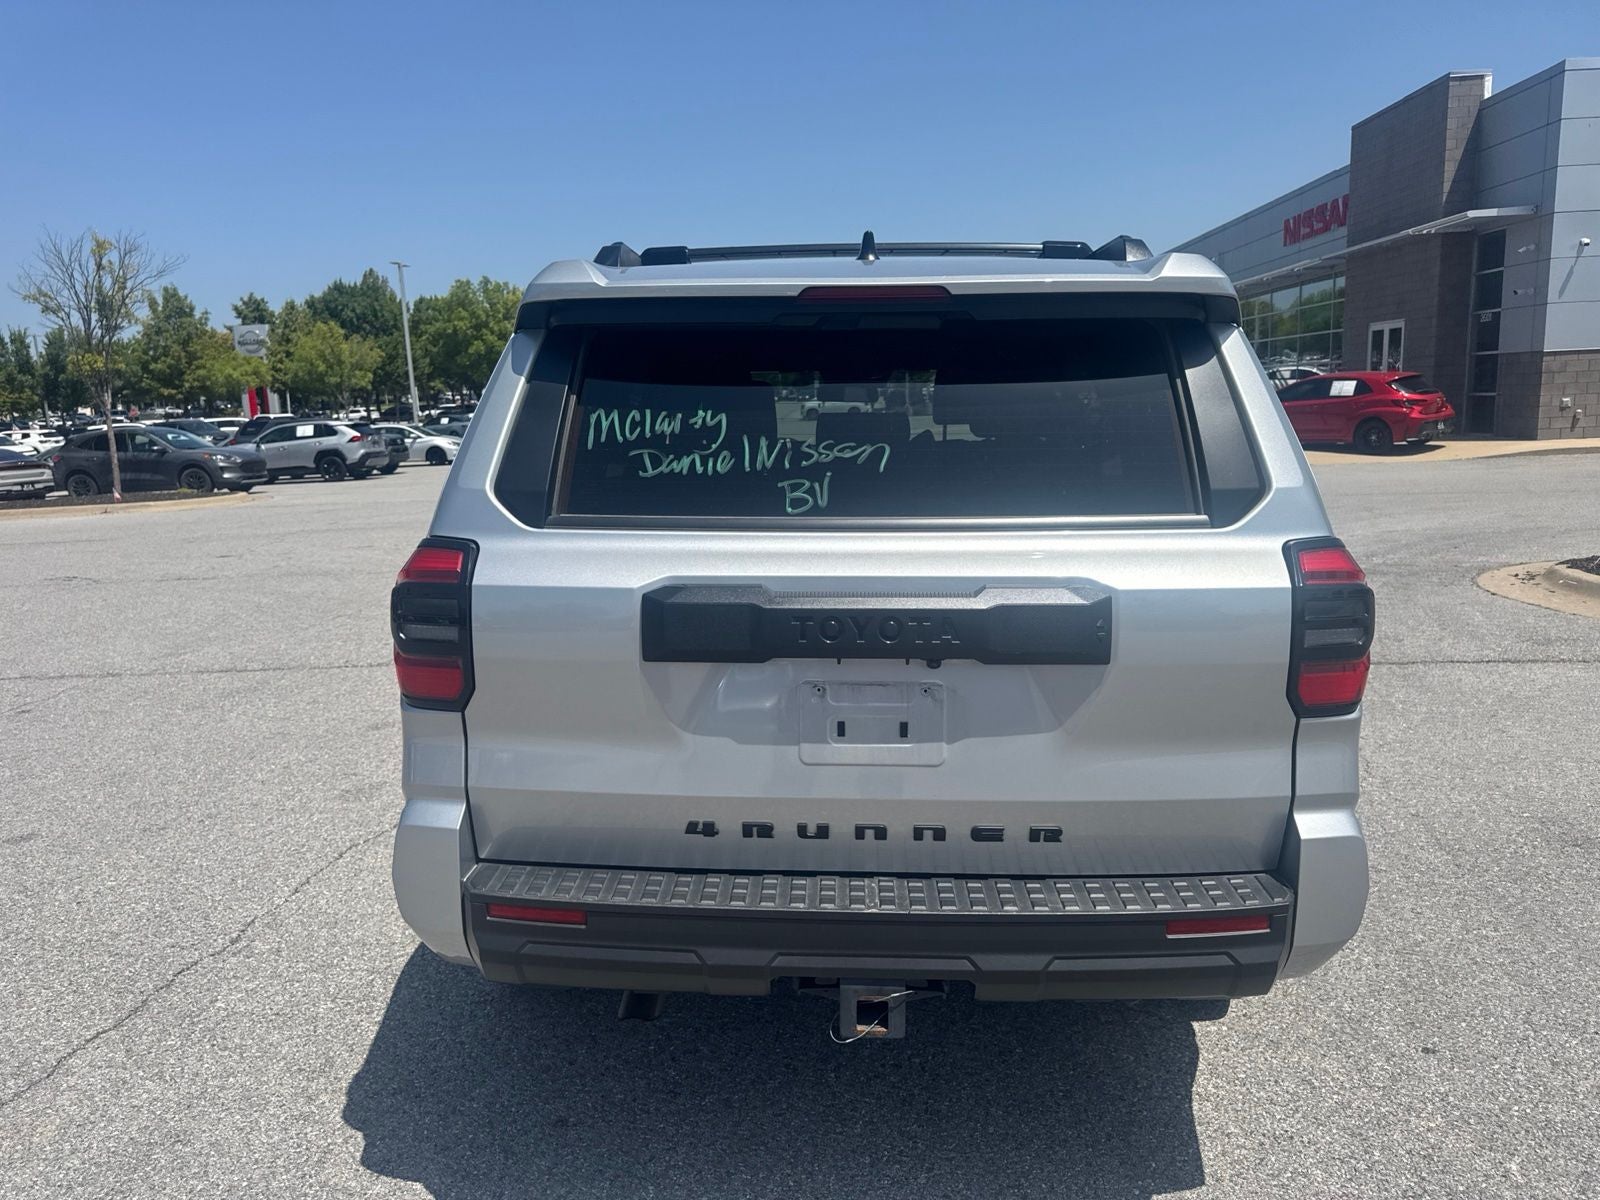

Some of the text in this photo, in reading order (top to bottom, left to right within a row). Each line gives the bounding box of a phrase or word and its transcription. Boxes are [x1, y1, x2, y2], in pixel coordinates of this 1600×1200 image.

[628, 435, 751, 478] Daniel
[777, 471, 833, 515] BV
[791, 615, 961, 644] TOYOTA
[684, 820, 1064, 844] 4RUNNER
